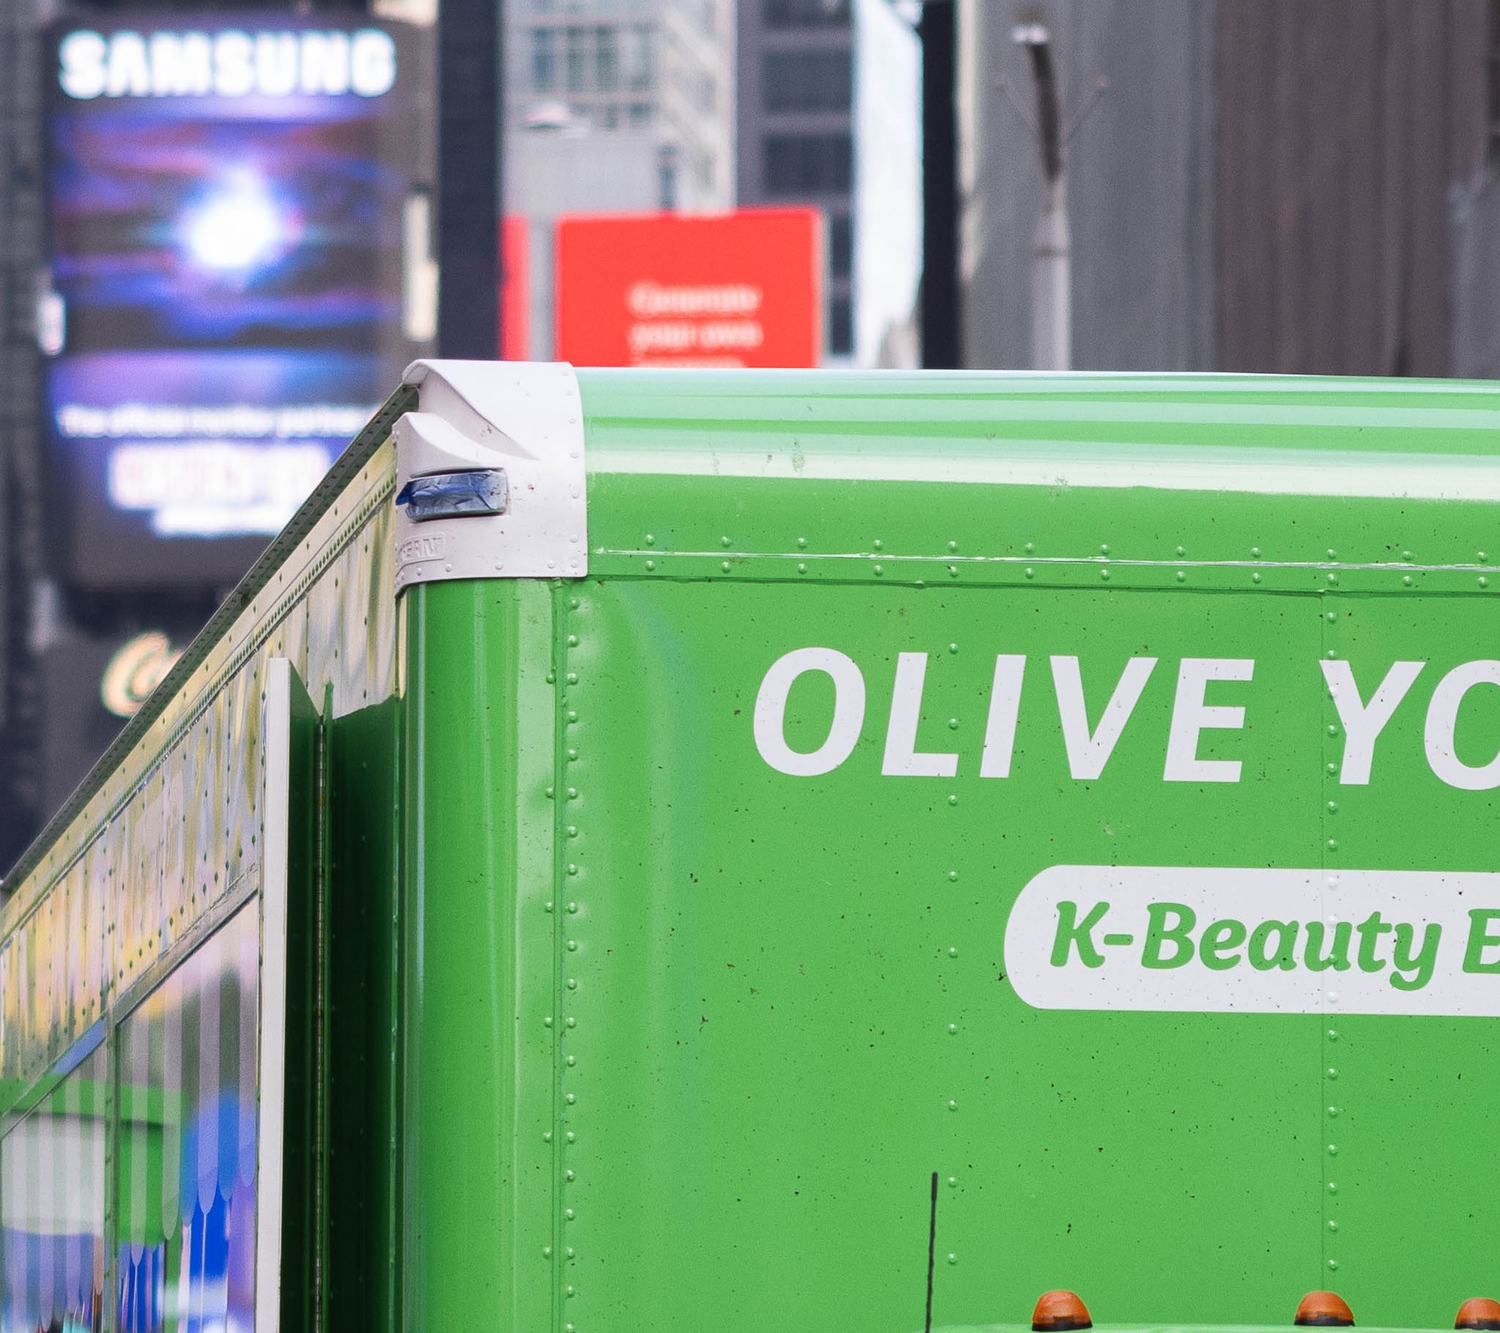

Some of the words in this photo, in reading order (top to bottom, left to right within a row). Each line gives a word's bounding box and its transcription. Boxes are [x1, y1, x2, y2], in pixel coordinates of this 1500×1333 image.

[59, 29, 397, 99] SAMSUNG
[751, 646, 1256, 784] OLIVE
[1048, 898, 1444, 993] K-Beauty
